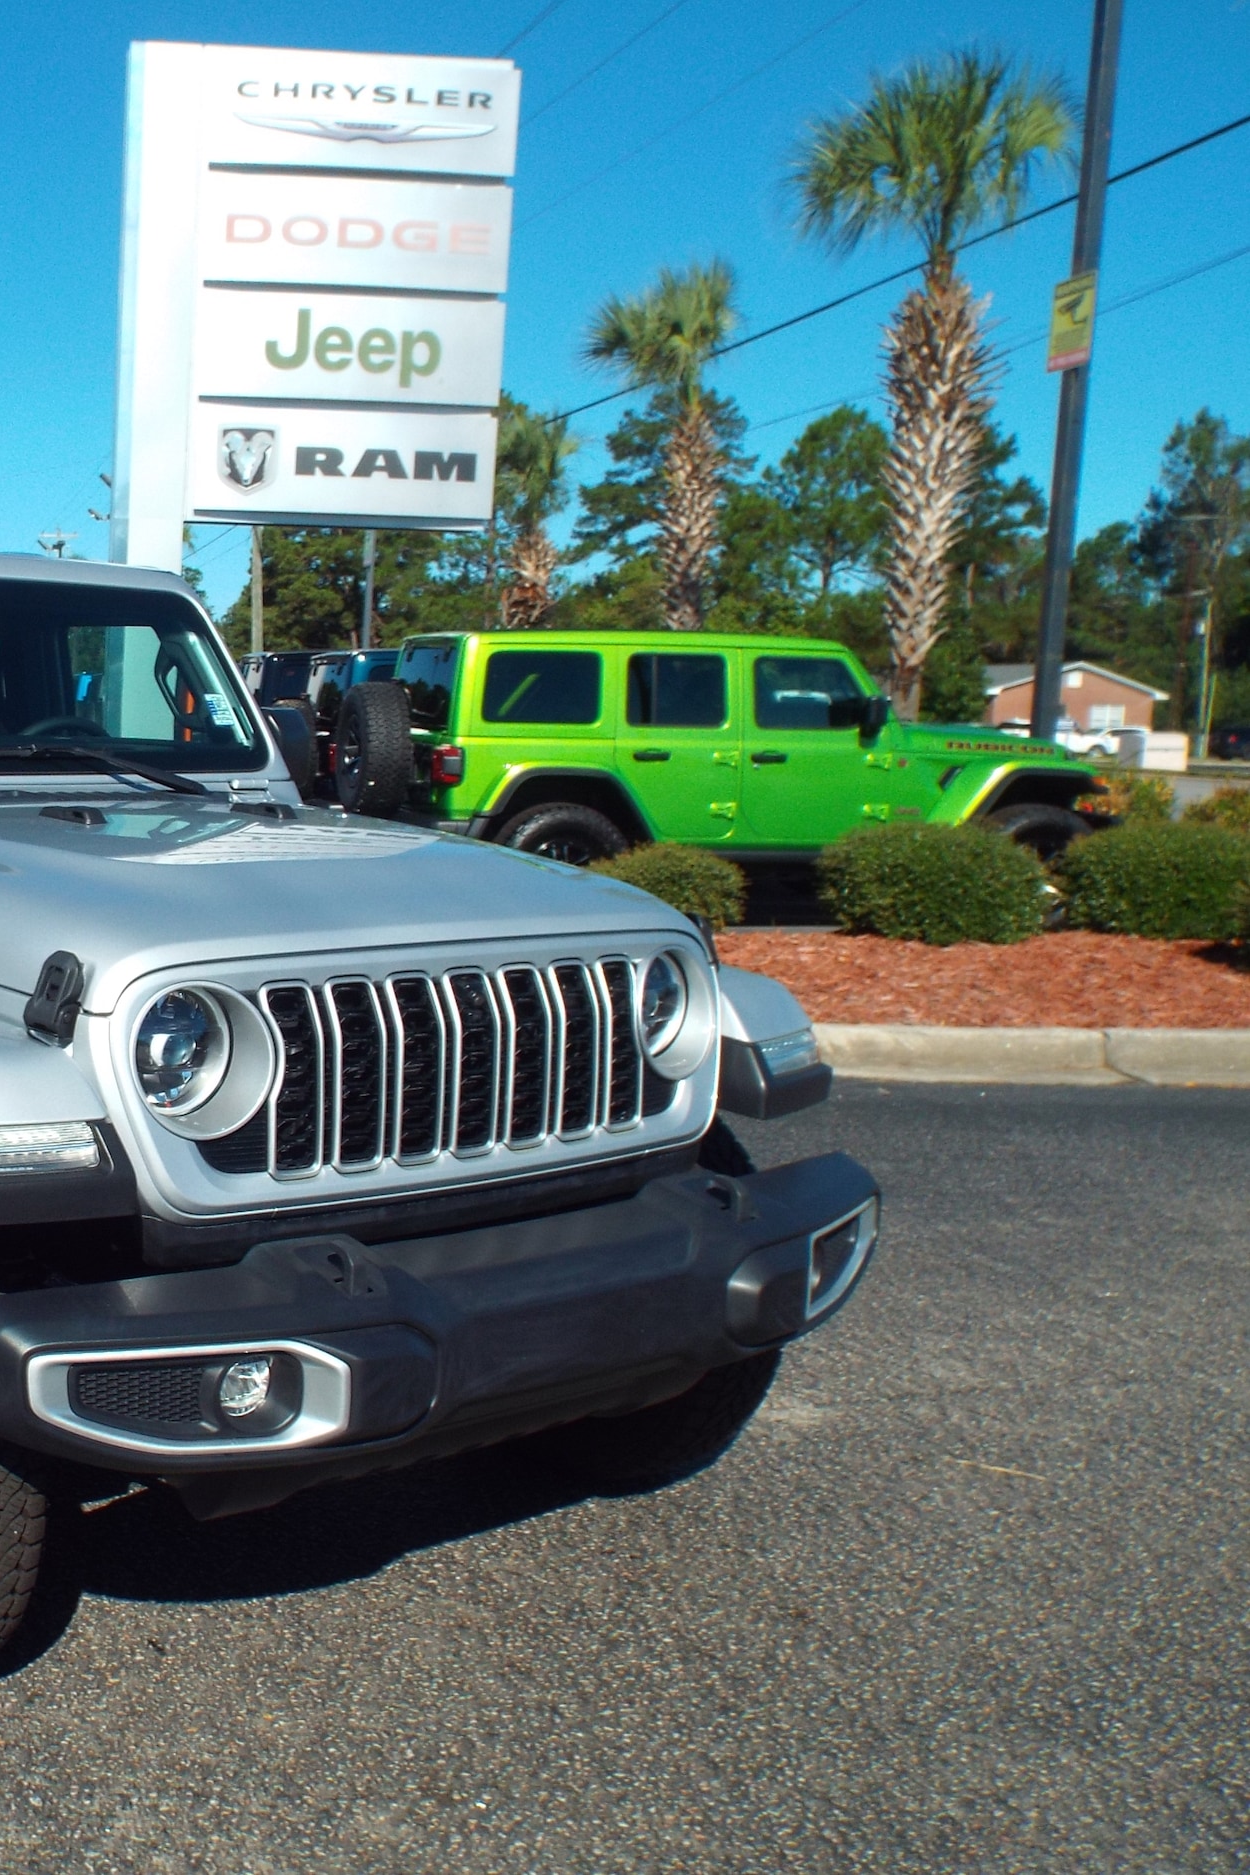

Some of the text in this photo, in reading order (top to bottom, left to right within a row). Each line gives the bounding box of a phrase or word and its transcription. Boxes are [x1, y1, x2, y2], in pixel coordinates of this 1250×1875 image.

[237, 80, 494, 110] CHRYSLER
[225, 213, 493, 254] DODGE
[265, 308, 442, 388] Jeep
[295, 446, 477, 483] RAM
